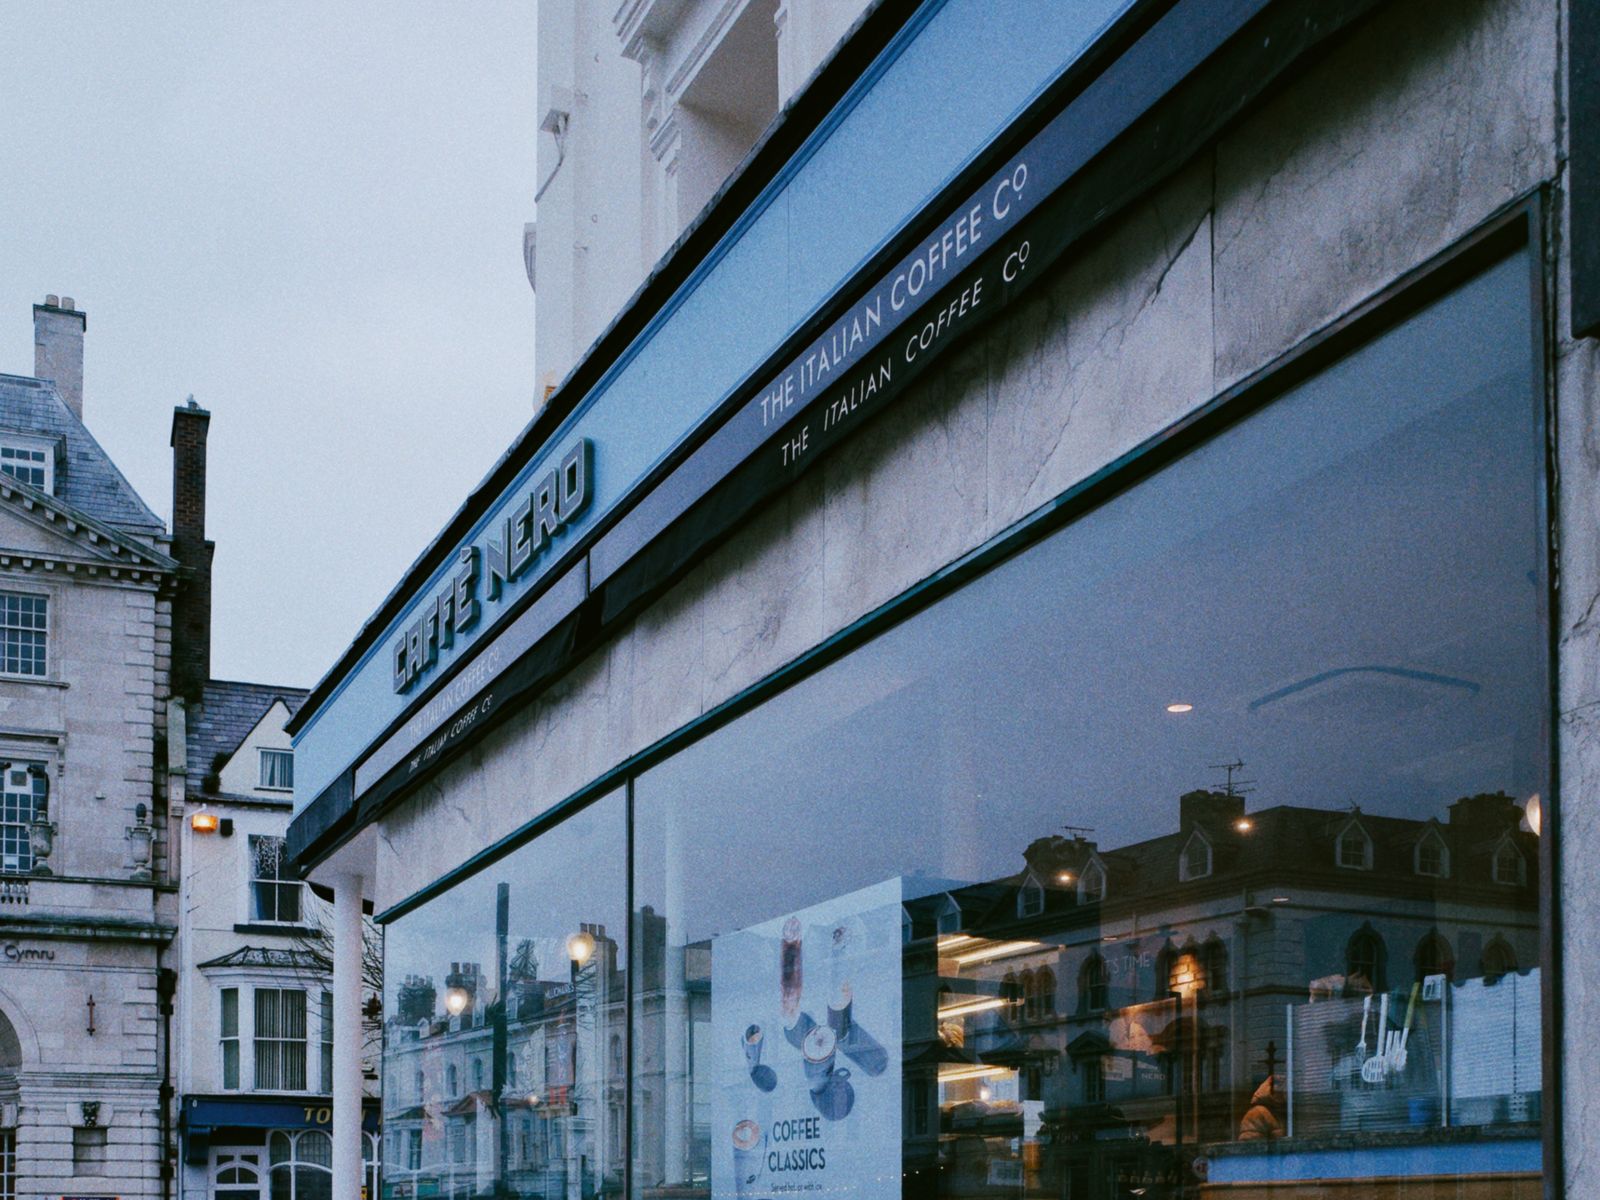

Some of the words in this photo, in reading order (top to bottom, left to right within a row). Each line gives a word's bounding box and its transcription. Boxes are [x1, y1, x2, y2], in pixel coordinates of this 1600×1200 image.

[760, 375, 793, 426] THE
[800, 296, 881, 394] ITALIAN
[890, 204, 982, 311] COFFEE
[782, 425, 809, 466] THE
[823, 358, 892, 432] ITALIAN
[905, 278, 982, 363] COFFEE
[486, 437, 593, 601] NERO
[421, 688, 455, 732] ITALIAN
[455, 661, 486, 702] COFFEE
[423, 729, 450, 761] ITALIAN
[450, 705, 479, 738] COFFEE
[4, 944, 55, 963] Cymru
[1122, 951, 1151, 971] TIME
[772, 1116, 821, 1143] COFFEE
[768, 1147, 826, 1172] CLASSICS
